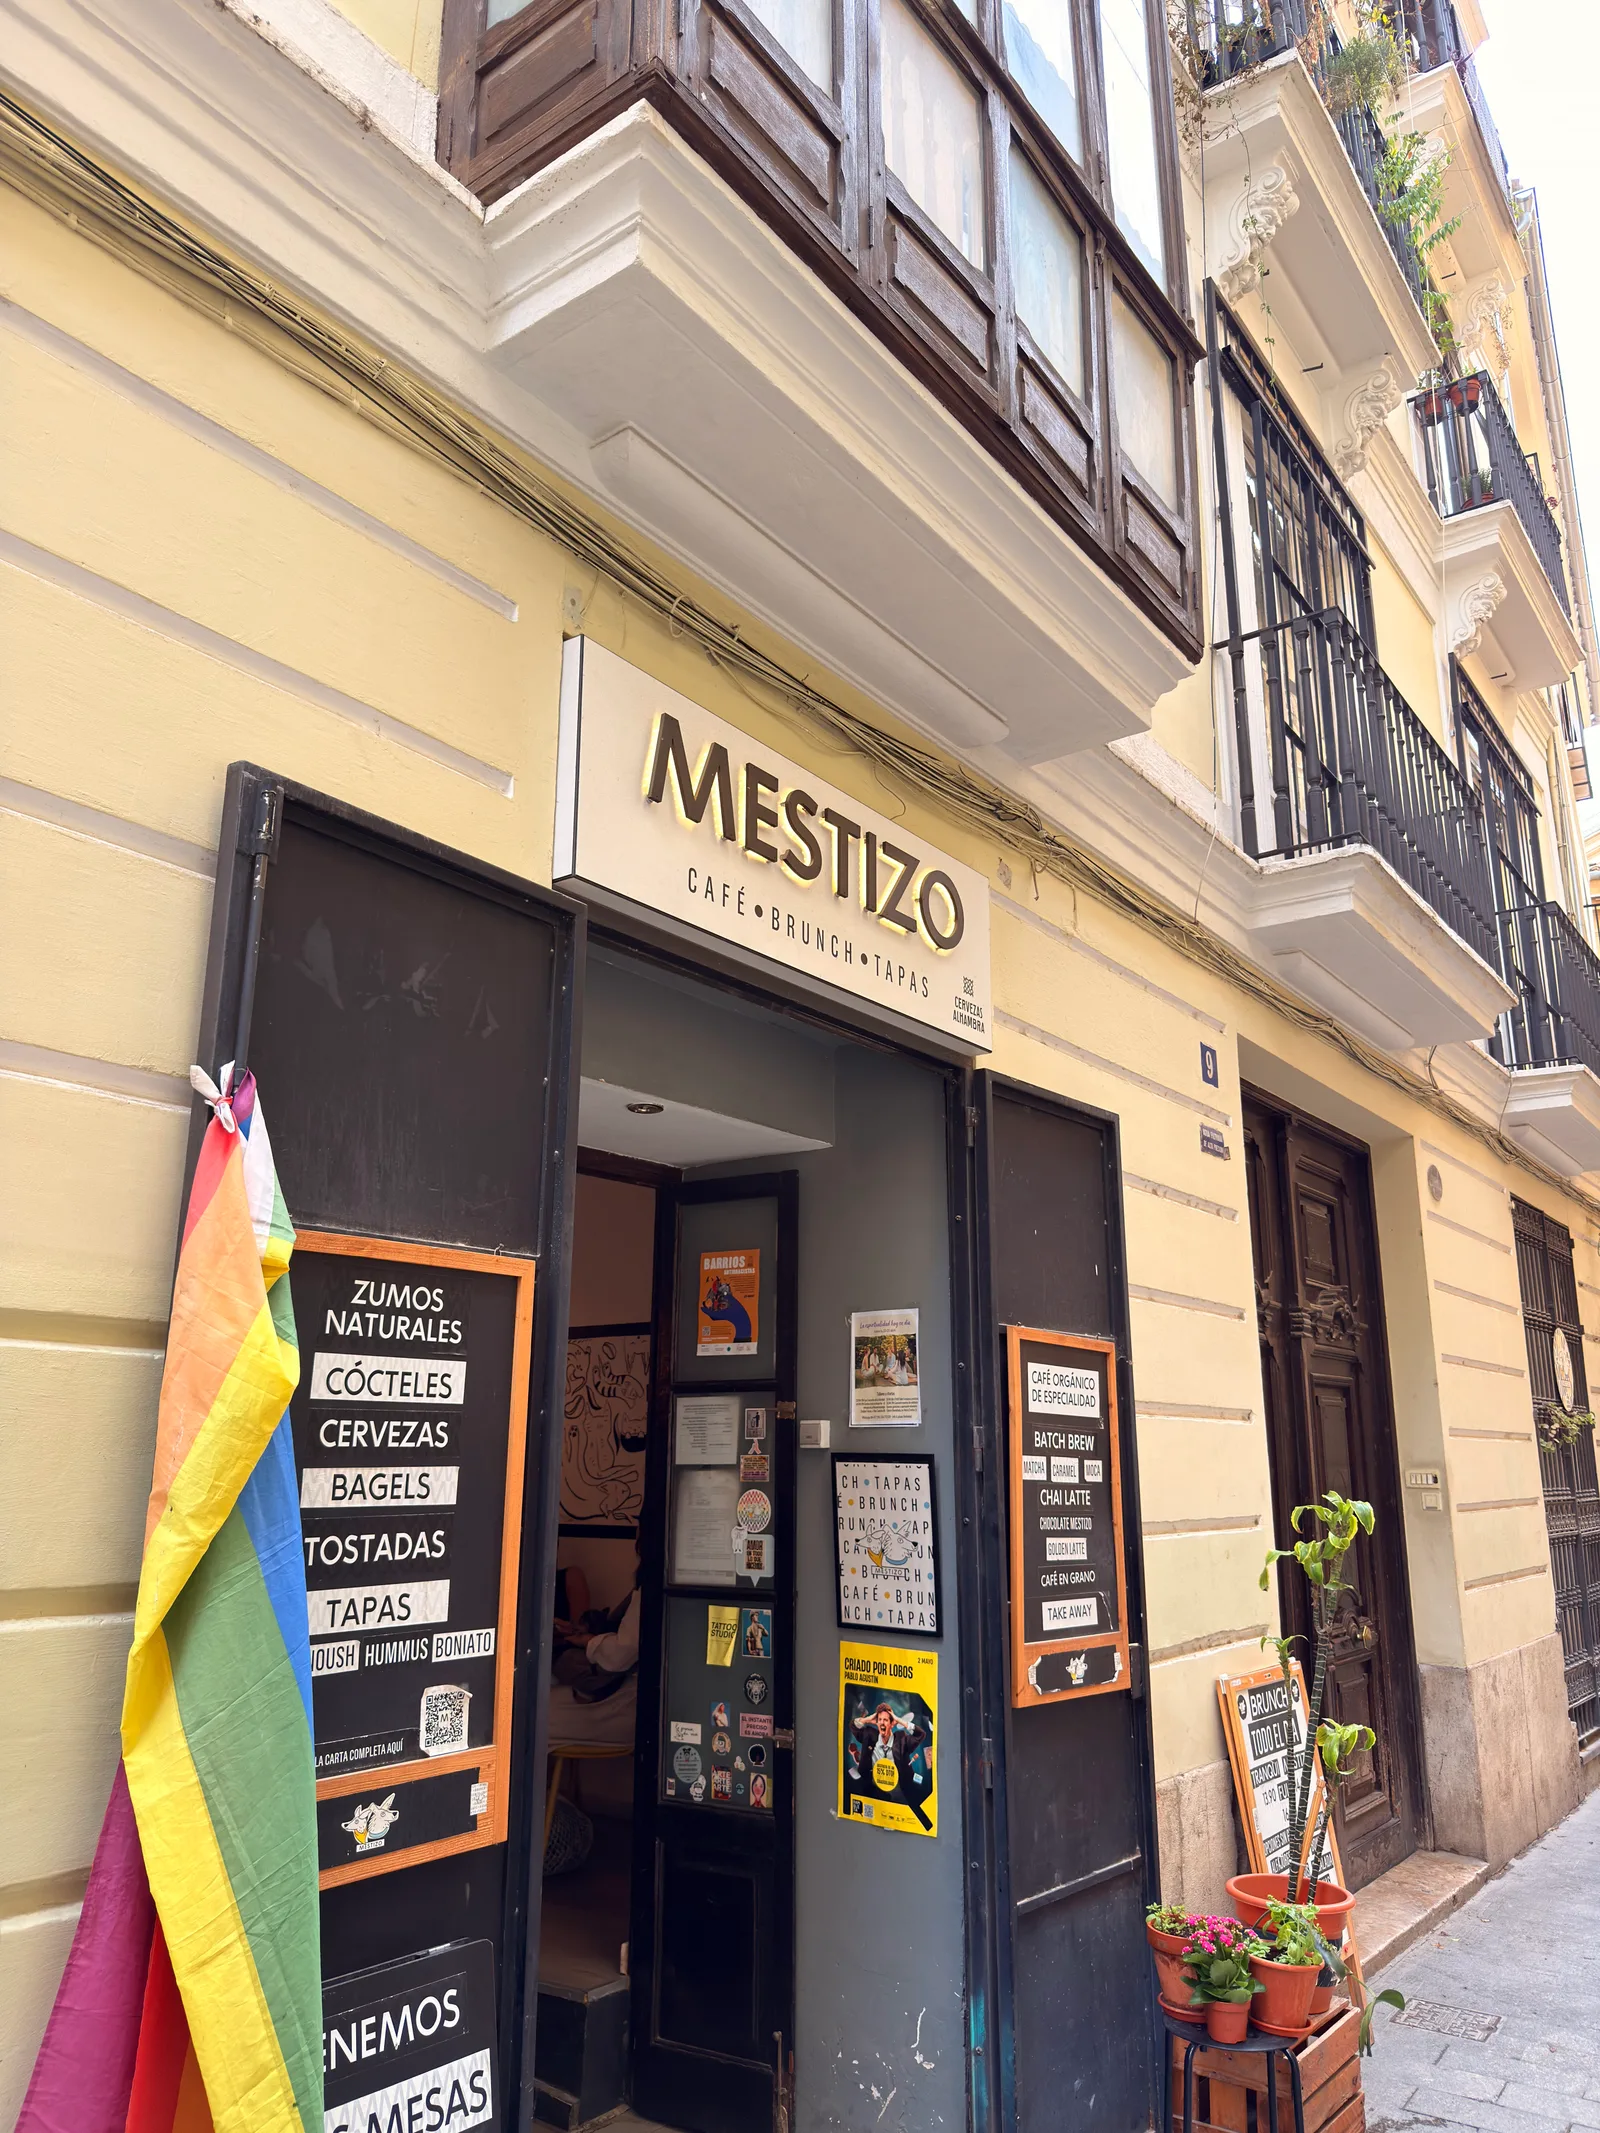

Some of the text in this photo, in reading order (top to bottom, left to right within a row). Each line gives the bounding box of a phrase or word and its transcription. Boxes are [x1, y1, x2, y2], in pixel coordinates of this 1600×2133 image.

[647, 712, 965, 951] MESTIZO
[688, 866, 930, 998] CAFÉ BRUNCH TAPAS
[953, 995, 984, 1020] CERVEZAS
[952, 1008, 986, 1035] ALHAMBRA
[1205, 1050, 1214, 1079] 9
[703, 1255, 746, 1271] BARRIOS
[350, 1279, 444, 1312] ZUMOS
[325, 1309, 462, 1344] NATURALES
[326, 1360, 453, 1399] CÓCTELES
[1031, 1368, 1096, 1391] CAFÉ ORGÁNICO
[1032, 1388, 1096, 1408] DE ESPECIALIDAD
[319, 1419, 449, 1448] CERVEZAS
[1034, 1430, 1095, 1452] BATCH BREW
[1023, 1460, 1045, 1474] MATCHA
[1052, 1463, 1077, 1478] CARAMEL
[1086, 1463, 1101, 1477] MOCA
[331, 1472, 431, 1501] BAGELS
[874, 1476, 921, 1491] TAPAS
[859, 1495, 918, 1512] BRUNCH
[1040, 1488, 1091, 1506] CHAI LATTE
[1039, 1516, 1093, 1531] CHOCOLATE MESTIZO
[304, 1530, 446, 1566] TOSTADAS
[1047, 1541, 1085, 1556] GOLDEN LATTE
[1040, 1570, 1096, 1587] CAFÉ EN GRANO
[843, 1584, 935, 1606] CAFÉ BRUN
[326, 1593, 412, 1628] TAPAS
[844, 1605, 936, 1628] NCH TAPAS
[1047, 1603, 1092, 1621] TAKE AWAY
[711, 1621, 738, 1631] TATTOO
[311, 1631, 492, 1672] OUSH HUMMUS BONIATO
[844, 1657, 914, 1679] CRIADO POR LOBOS
[844, 1671, 858, 1681] PABLO
[1250, 1686, 1289, 1717] BRUNCH
[1250, 1725, 1273, 1757] TODO
[1272, 1722, 1285, 1749] EL
[325, 1750, 349, 1766] CARTA
[349, 1743, 386, 1761] COMPLETA
[387, 1737, 404, 1755] AQUÍ
[358, 1840, 383, 1851] MESTIZO
[323, 1988, 460, 2073] NEMOS
